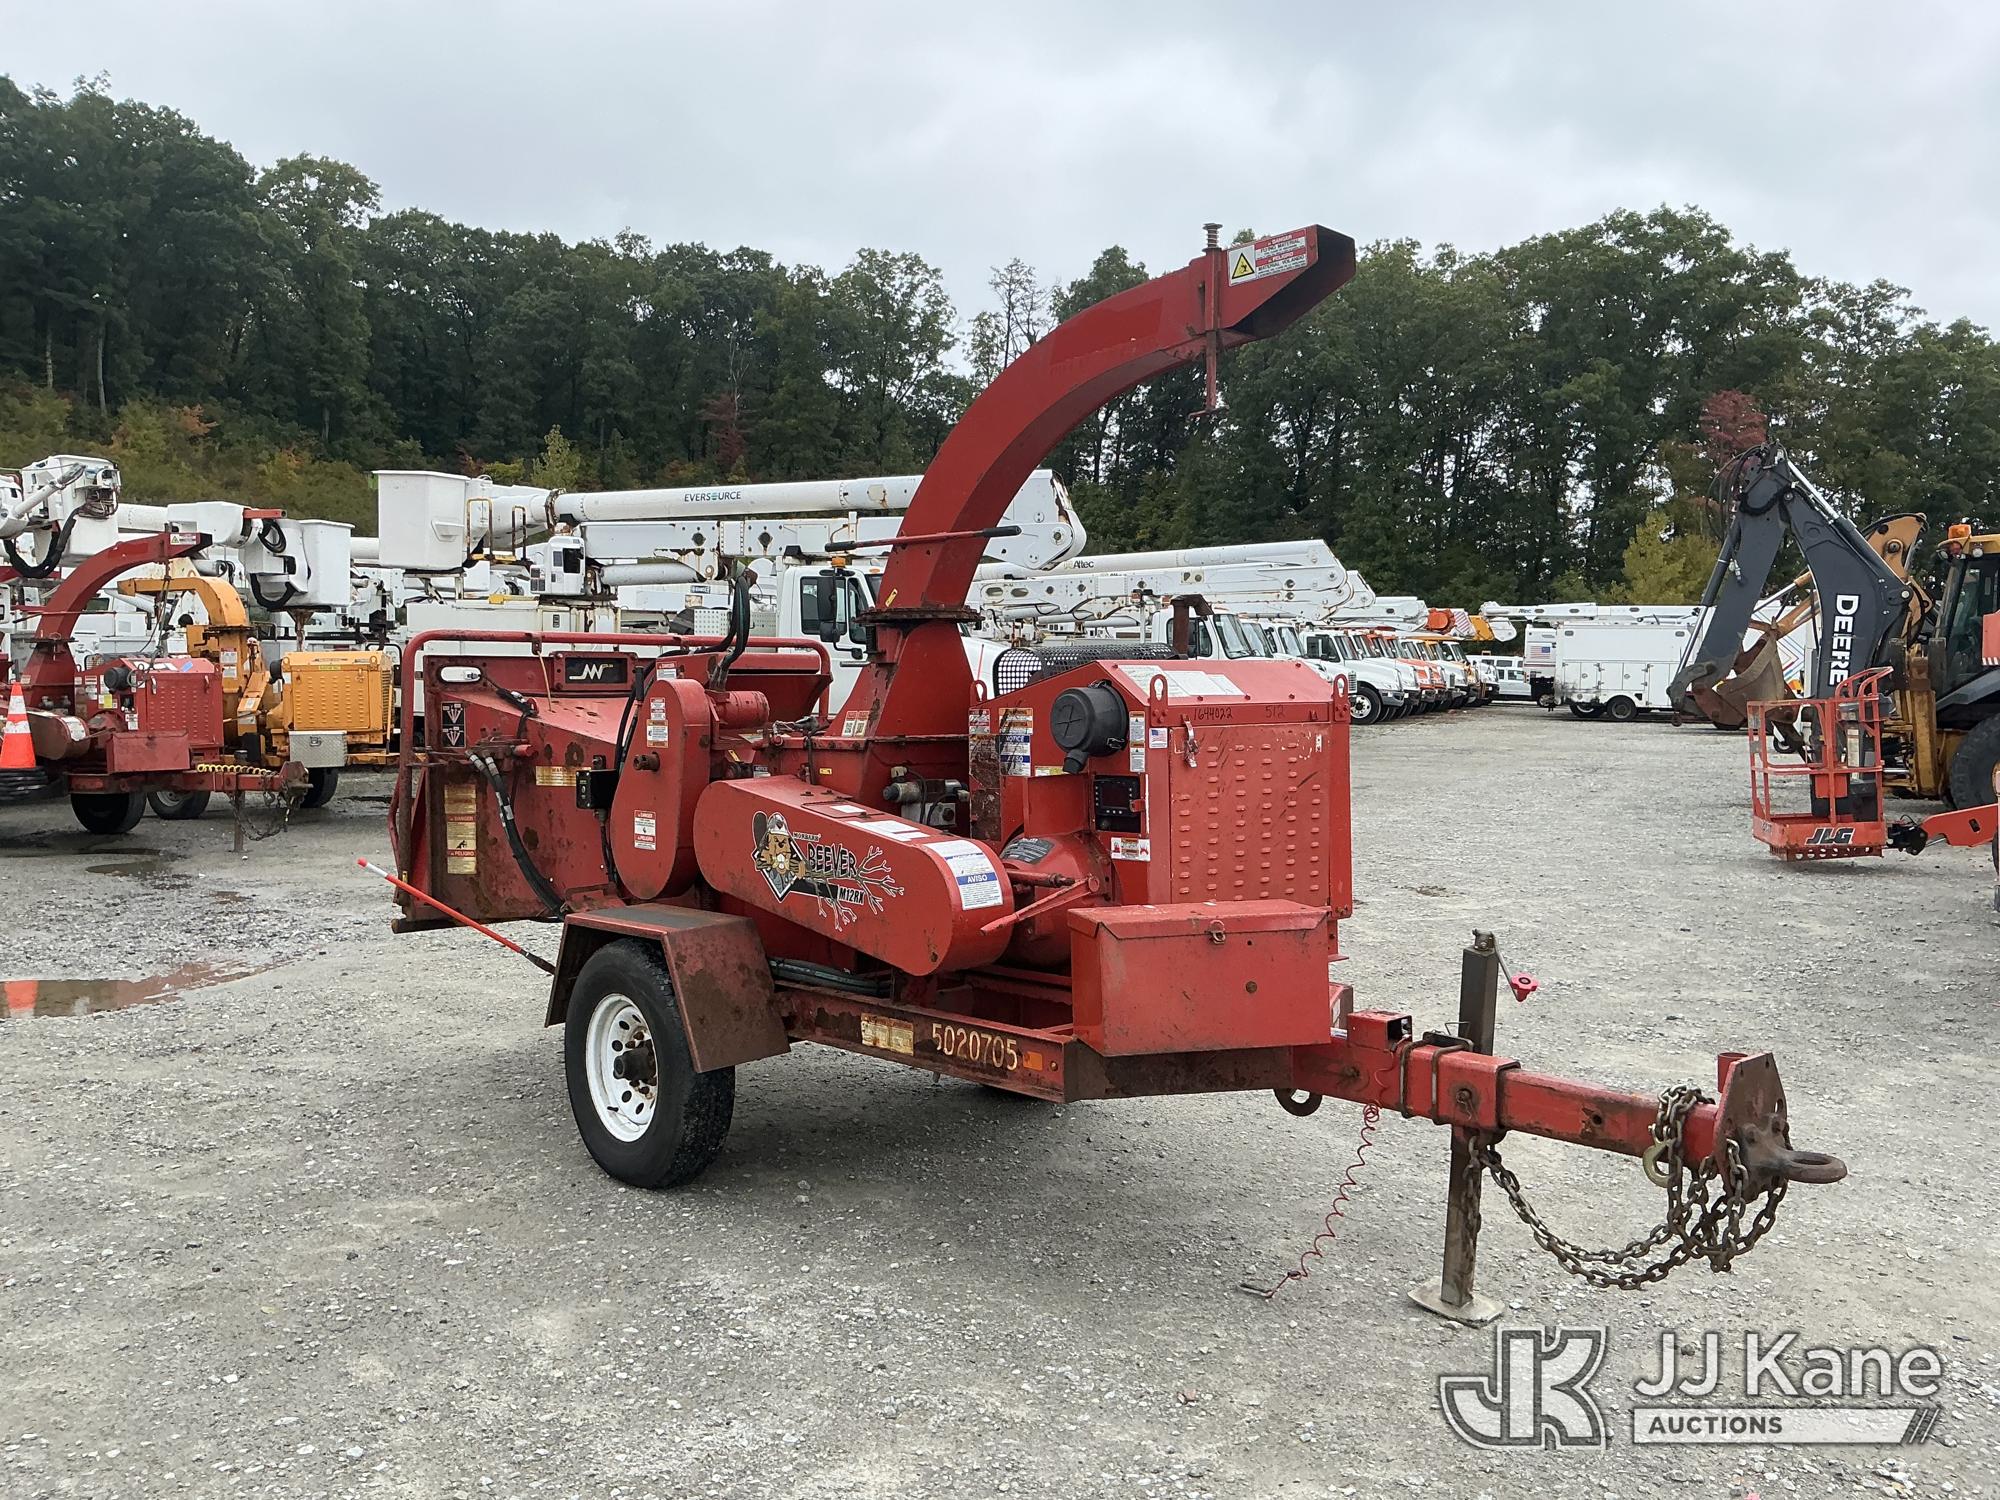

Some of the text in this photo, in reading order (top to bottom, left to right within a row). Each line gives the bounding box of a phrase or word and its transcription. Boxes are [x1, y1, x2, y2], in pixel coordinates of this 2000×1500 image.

[1271, 235, 1293, 245] DANGER
[1073, 560, 1094, 569] Altec
[1829, 594, 1860, 686] DEERE
[1193, 706, 1233, 721] 1644022
[1804, 826, 1855, 846] JLG
[807, 843, 858, 878] BEEVER
[967, 874, 988, 884] AVISO
[839, 886, 864, 905] M12RX
[931, 1023, 1018, 1071] 5020705
